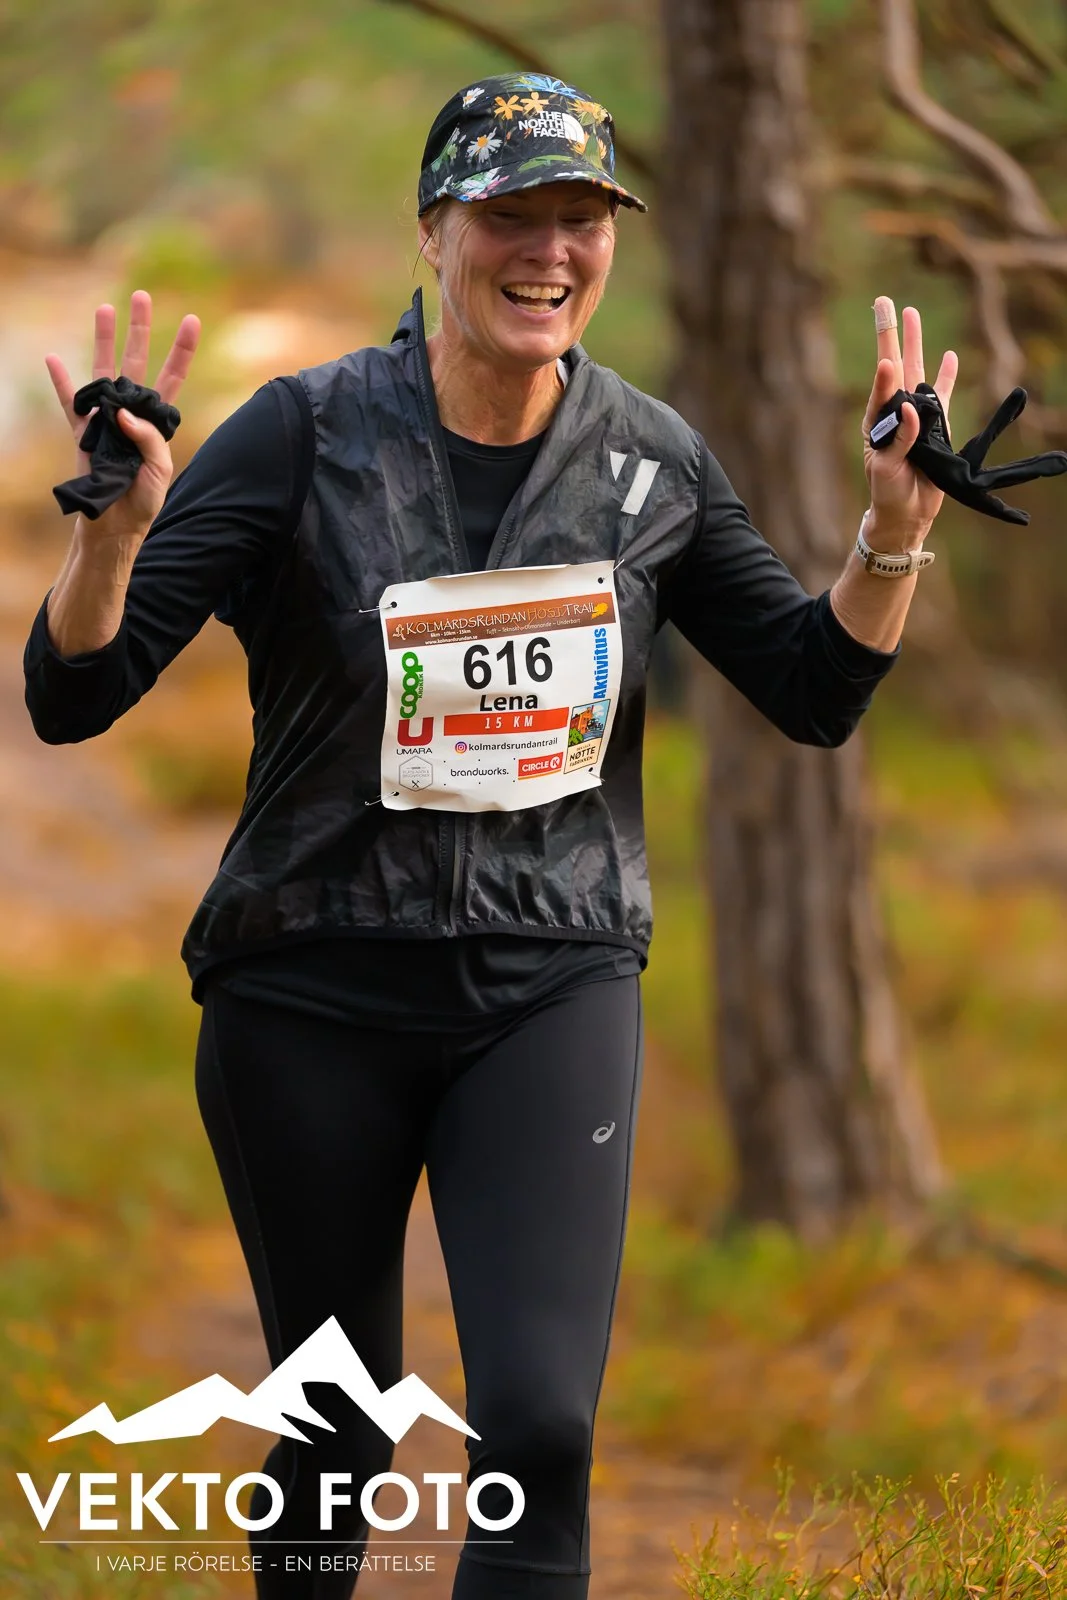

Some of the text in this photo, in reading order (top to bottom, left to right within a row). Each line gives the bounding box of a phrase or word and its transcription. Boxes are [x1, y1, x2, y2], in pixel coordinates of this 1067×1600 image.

[538, 110, 562, 120] THE
[518, 119, 564, 131] NORTH
[533, 128, 566, 139] FACE
[463, 636, 553, 690] 616
[593, 627, 609, 700] Aktivitus
[400, 651, 424, 719] coop
[479, 694, 539, 712] Lena
[484, 715, 534, 729] 15 KM
[396, 747, 433, 755] UMARA
[468, 737, 558, 752] kolmardsrundantrail
[569, 746, 596, 762] NØTTE
[450, 764, 509, 778] brandworks.
[522, 757, 560, 772] CIRCLE K
